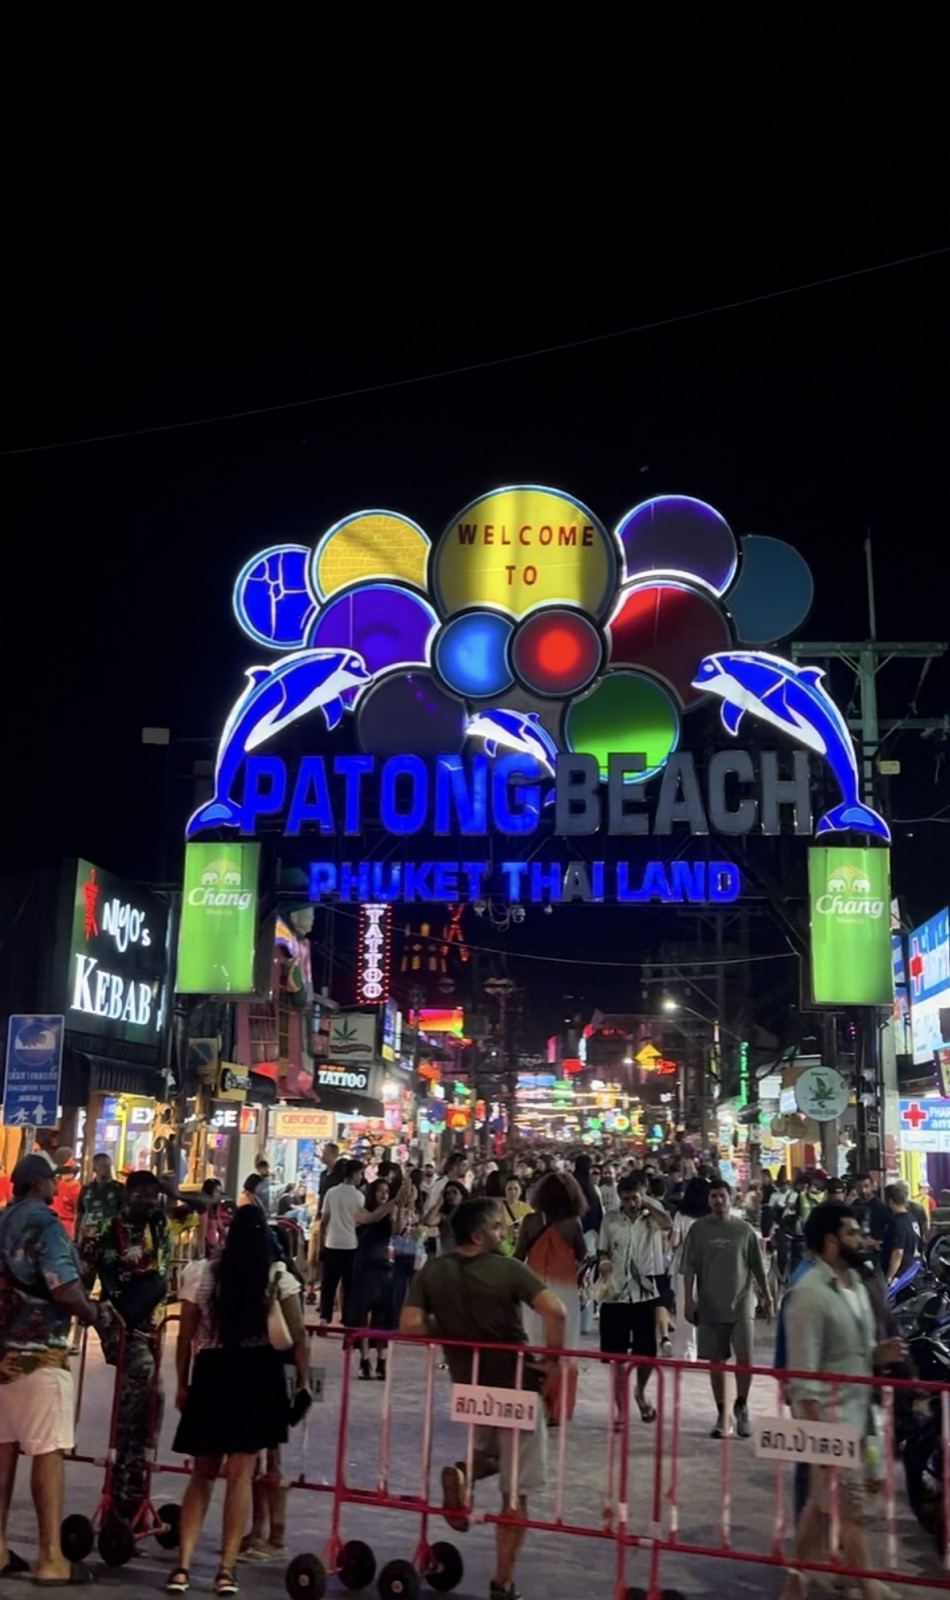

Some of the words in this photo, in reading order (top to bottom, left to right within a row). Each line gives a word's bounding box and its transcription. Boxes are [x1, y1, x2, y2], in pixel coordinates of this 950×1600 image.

[457, 523, 596, 547] WELCOME
[504, 565, 538, 586] TO
[239, 752, 541, 837] PATONG
[554, 750, 815, 838] BEACH
[308, 860, 488, 903] PHUKET
[187, 887, 252, 911] Chang
[815, 893, 885, 920] Chang
[361, 908, 385, 999] TATTOO
[318, 1070, 367, 1088] TATTOO
